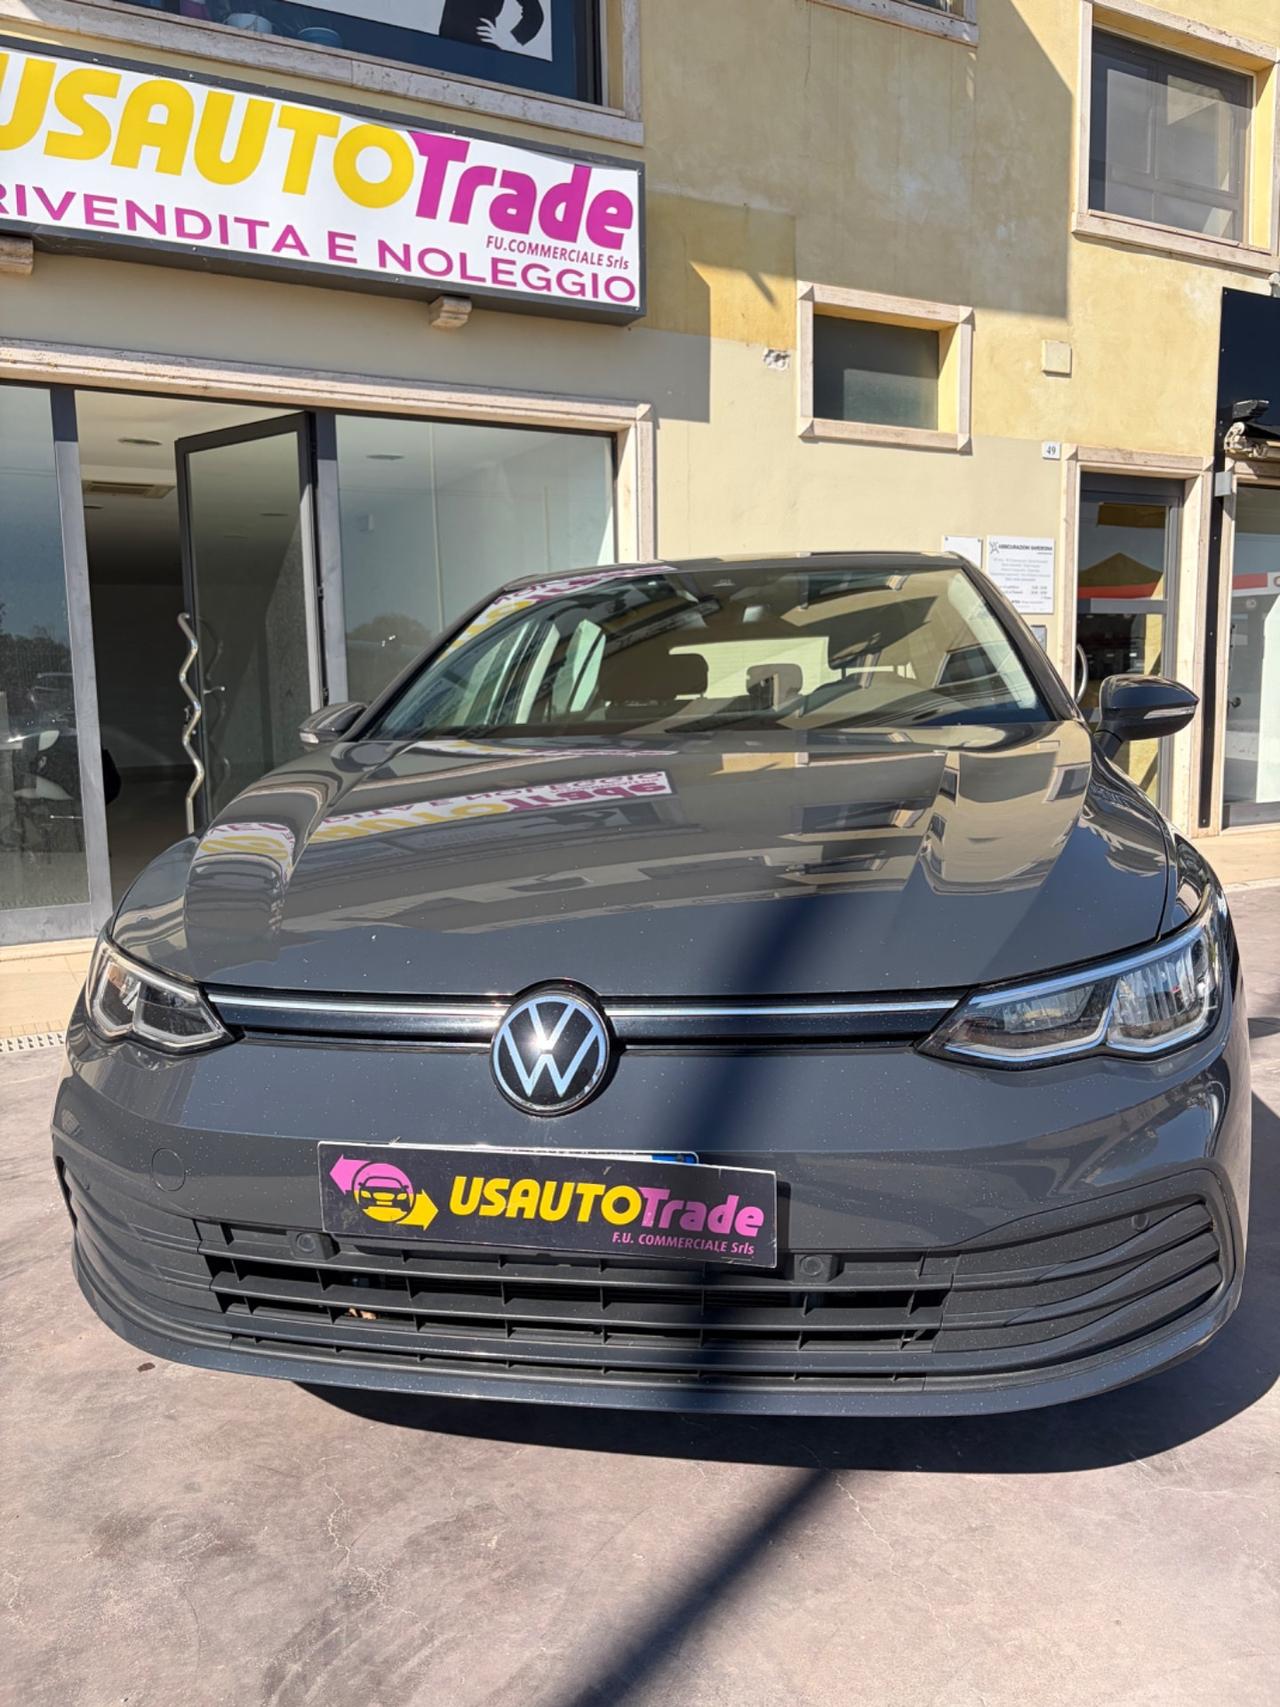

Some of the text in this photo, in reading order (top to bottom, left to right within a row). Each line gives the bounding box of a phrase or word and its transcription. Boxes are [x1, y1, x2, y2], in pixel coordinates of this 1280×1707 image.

[327, 230, 358, 264] E
[377, 238, 636, 303] NOLEGGIO
[606, 255, 629, 270] Srls
[1046, 445, 1057, 456] 49
[638, 1233, 727, 1252] COMMERCIALE
[731, 1241, 755, 1255] Srls
